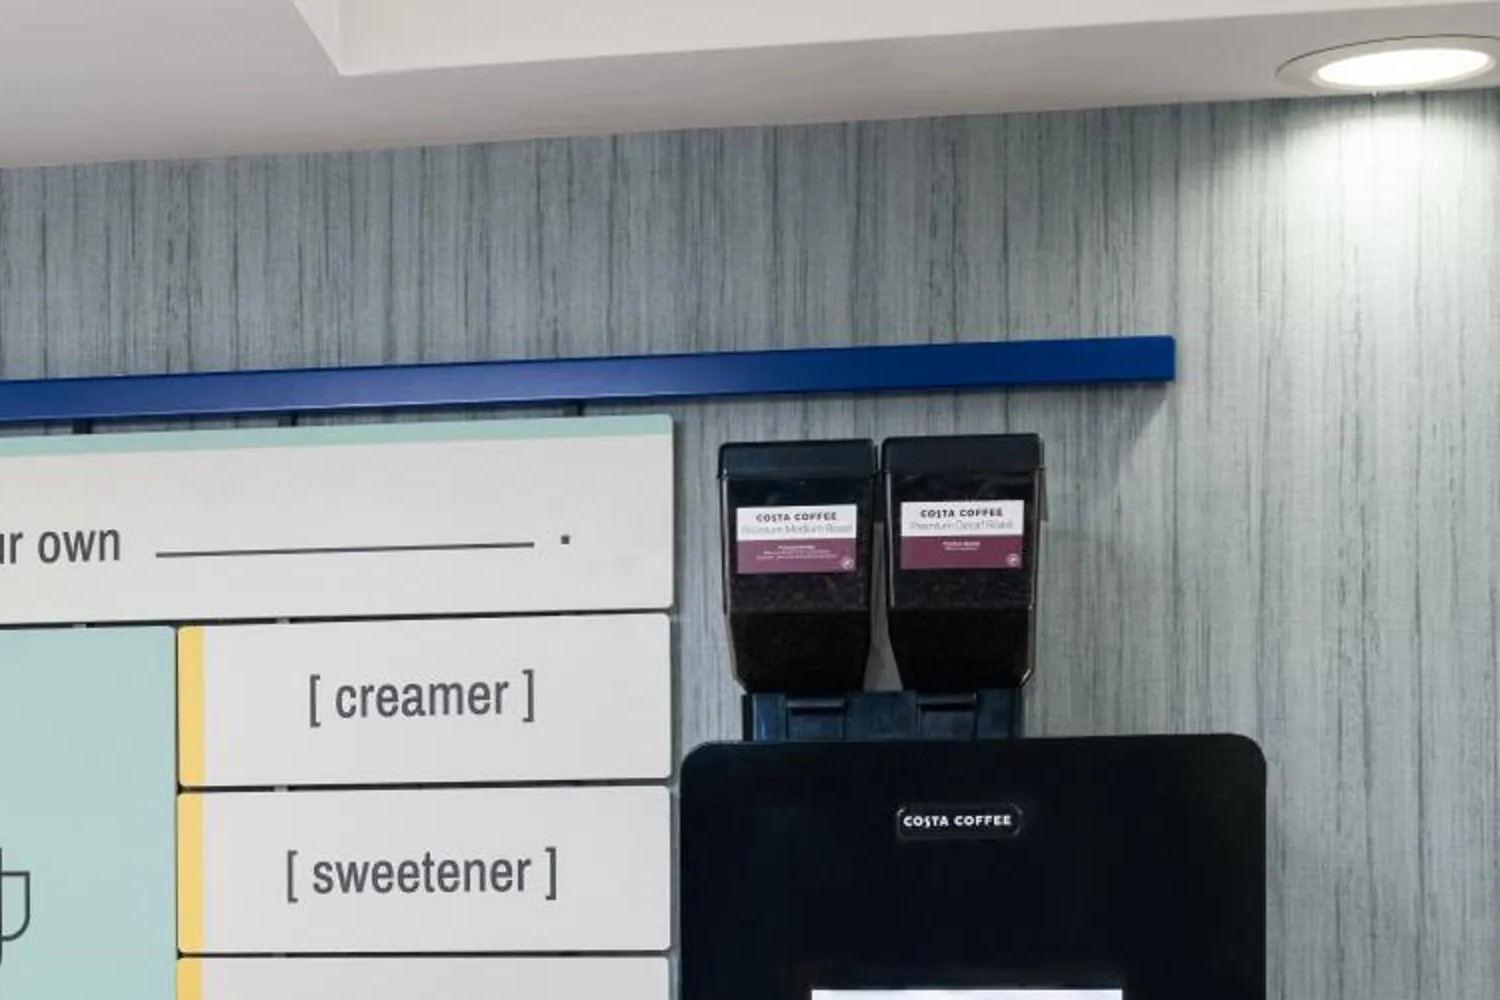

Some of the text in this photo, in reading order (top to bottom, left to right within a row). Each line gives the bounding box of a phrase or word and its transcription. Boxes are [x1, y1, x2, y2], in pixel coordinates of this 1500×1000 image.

[756, 511, 837, 522] COSTA COFFEE
[921, 507, 1002, 518] COSTA COFFEE
[37, 527, 121, 564] own
[903, 814, 1012, 828] COSTA COFFEE
